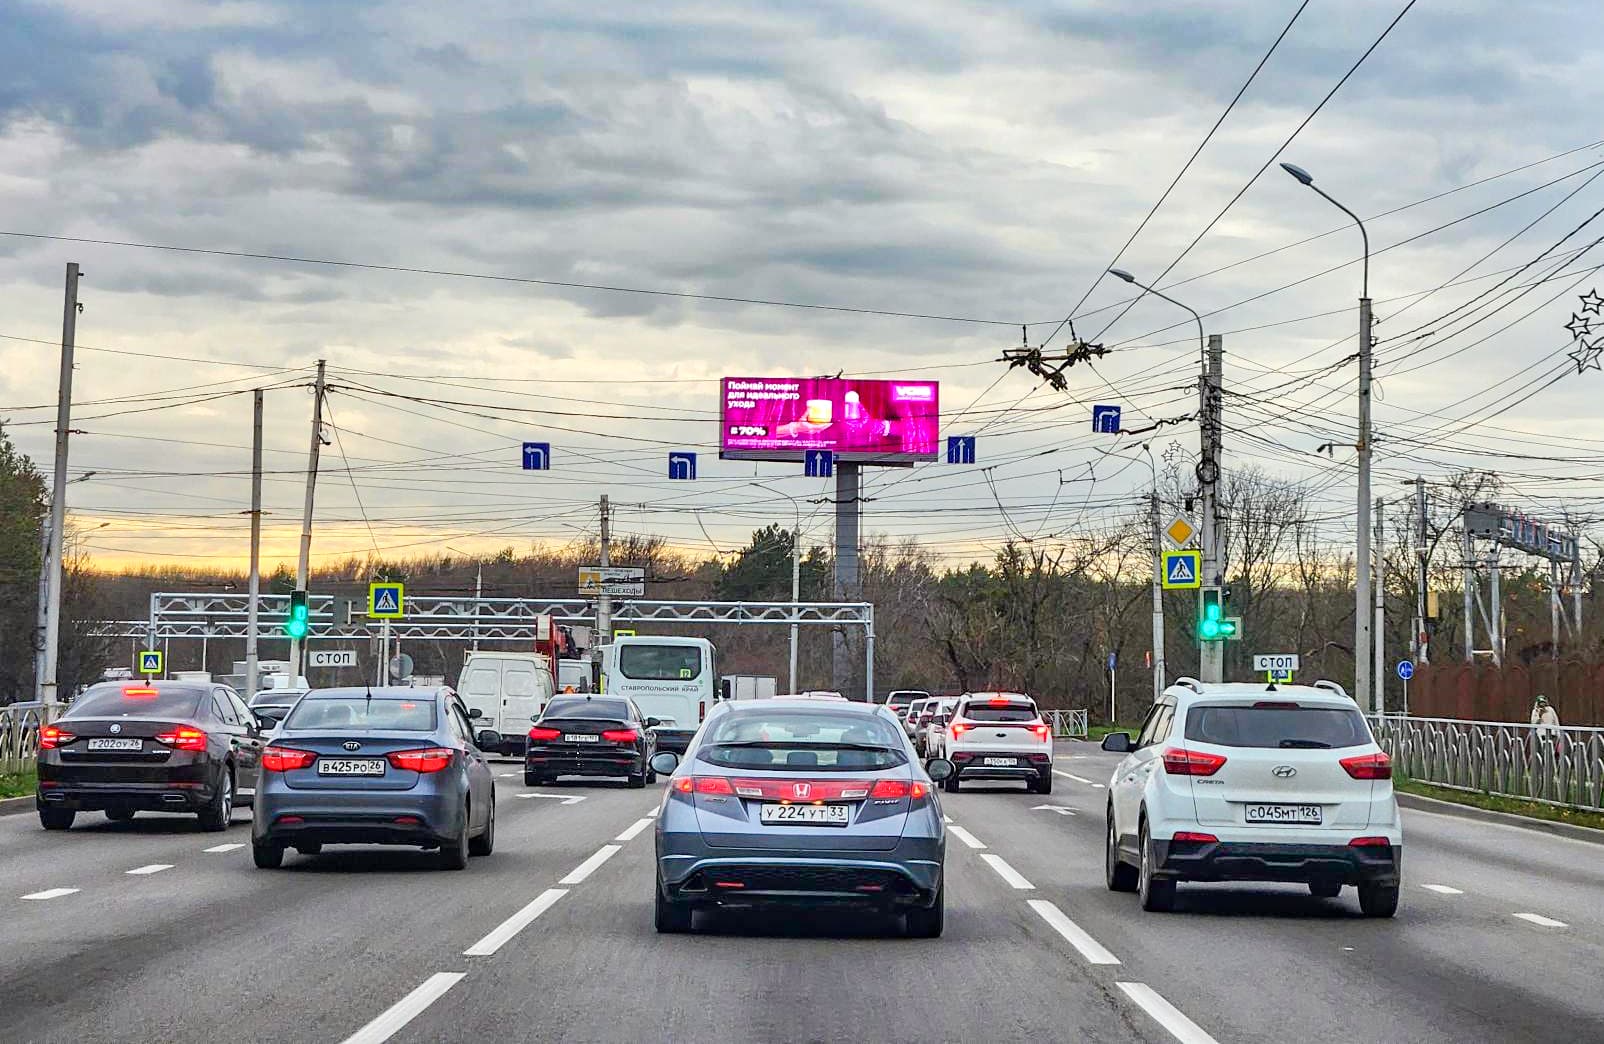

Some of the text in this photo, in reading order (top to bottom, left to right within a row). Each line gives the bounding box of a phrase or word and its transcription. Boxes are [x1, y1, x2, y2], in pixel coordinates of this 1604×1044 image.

[728, 381, 800, 392] Поймай момент
[728, 391, 746, 400] для
[728, 400, 755, 409] ухода
[316, 653, 350, 664] СТОП
[1260, 657, 1293, 668] СТОП
